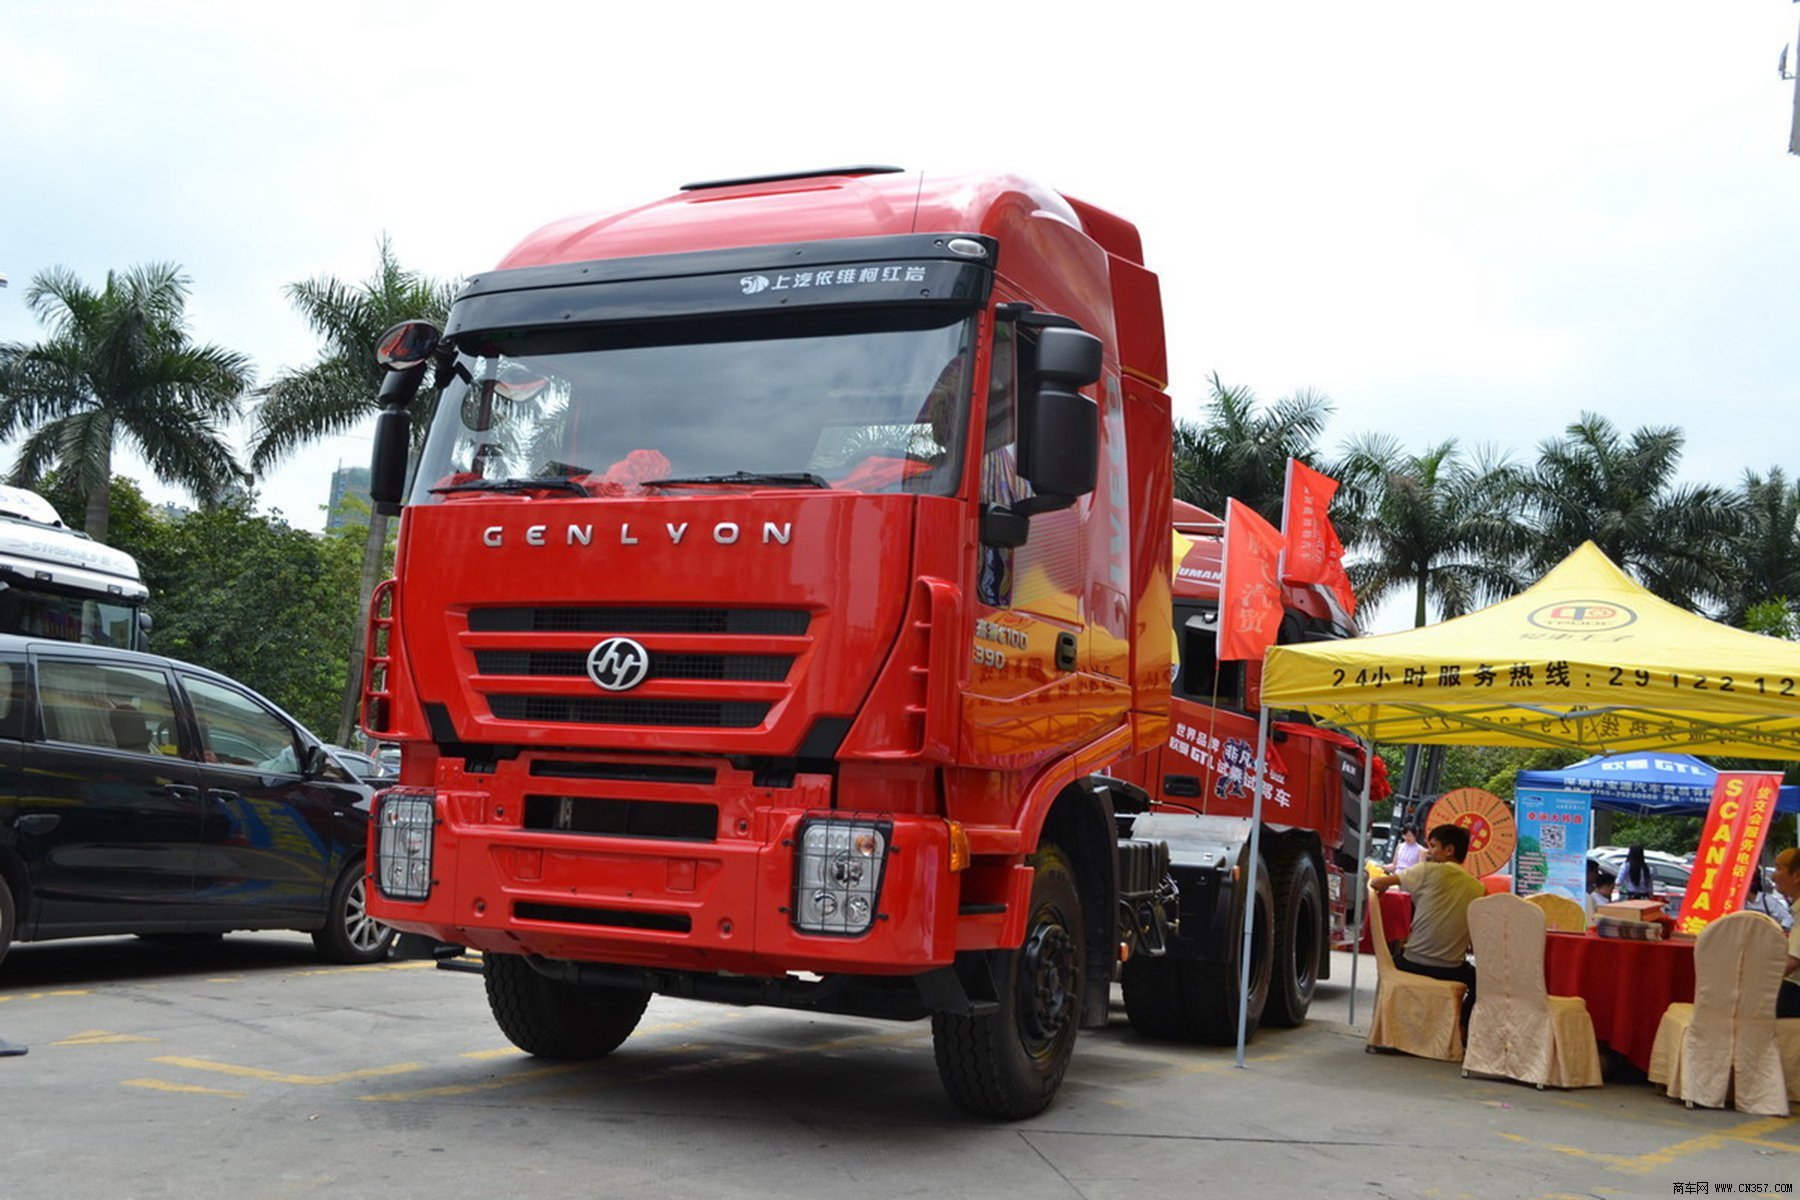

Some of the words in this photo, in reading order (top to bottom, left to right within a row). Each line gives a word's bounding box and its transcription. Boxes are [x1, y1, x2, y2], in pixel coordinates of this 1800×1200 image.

[771, 266, 926, 291] 上汽依维柯红岩
[483, 522, 792, 547] GENLYON
[1177, 566, 1223, 580] UMAN
[1654, 759, 1707, 776] GTL
[1692, 778, 1744, 911] SCANIA
